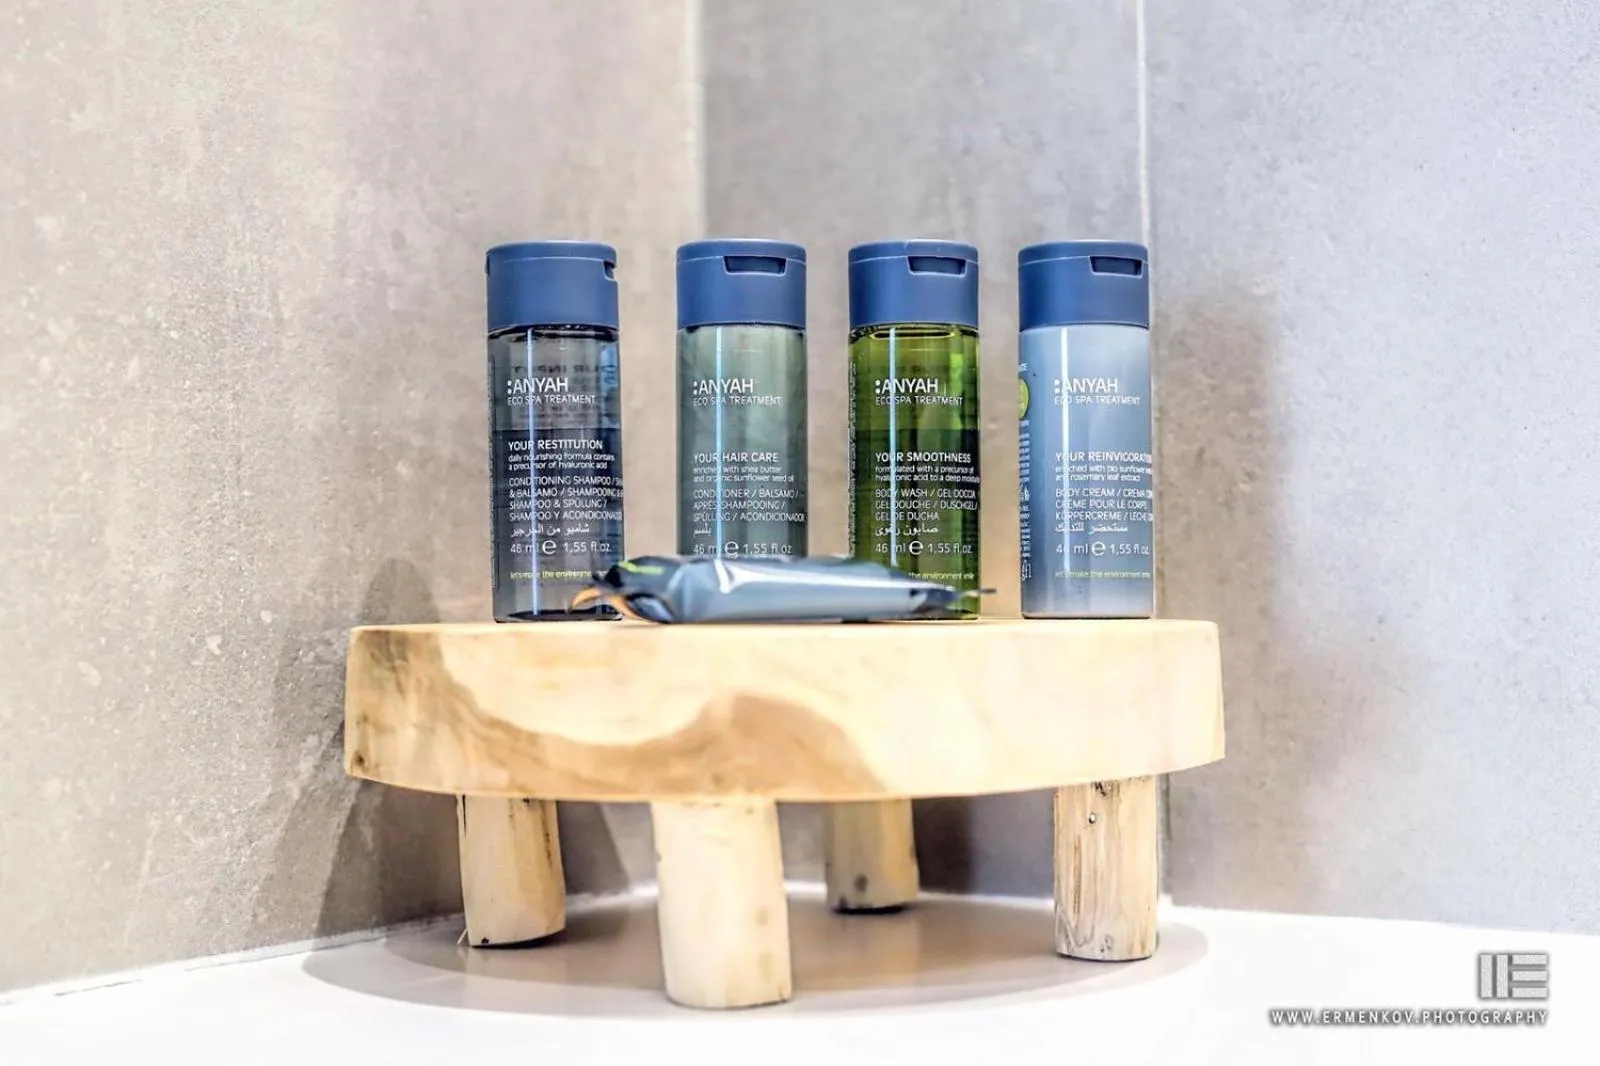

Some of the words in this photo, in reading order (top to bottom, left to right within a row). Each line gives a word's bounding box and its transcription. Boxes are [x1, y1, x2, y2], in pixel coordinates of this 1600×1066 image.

[507, 396, 523, 406] ECO
[544, 394, 596, 405] TREATMENT
[711, 396, 727, 406] SA
[729, 394, 783, 407] TREATMENT
[895, 395, 912, 406] SPA
[914, 395, 964, 406] TREATMENT
[1054, 395, 1073, 406] EO
[1095, 395, 1141, 406] TREATMENT
[508, 440, 534, 452] YOUR
[537, 438, 604, 451] RESTITUTION
[693, 453, 720, 464] YOUR
[722, 452, 748, 463] HAIR
[750, 452, 780, 463] CARE
[906, 451, 972, 464] SMOOTHNESS
[513, 461, 546, 472] precusor
[693, 466, 720, 475] enriche
[875, 465, 915, 474] formlated
[1055, 465, 1088, 474] enched
[508, 475, 572, 487] CONDTIONING
[573, 475, 611, 487] SHAMPOO
[706, 475, 732, 484] orgnic
[875, 474, 912, 484] hyalonic
[692, 488, 750, 499] CONDIONER
[901, 488, 929, 499] WASH
[1082, 488, 1115, 498] CREAM
[1088, 499, 1115, 510] POUR
[906, 511, 941, 521] DUCHA
[1056, 543, 1069, 554] 4
